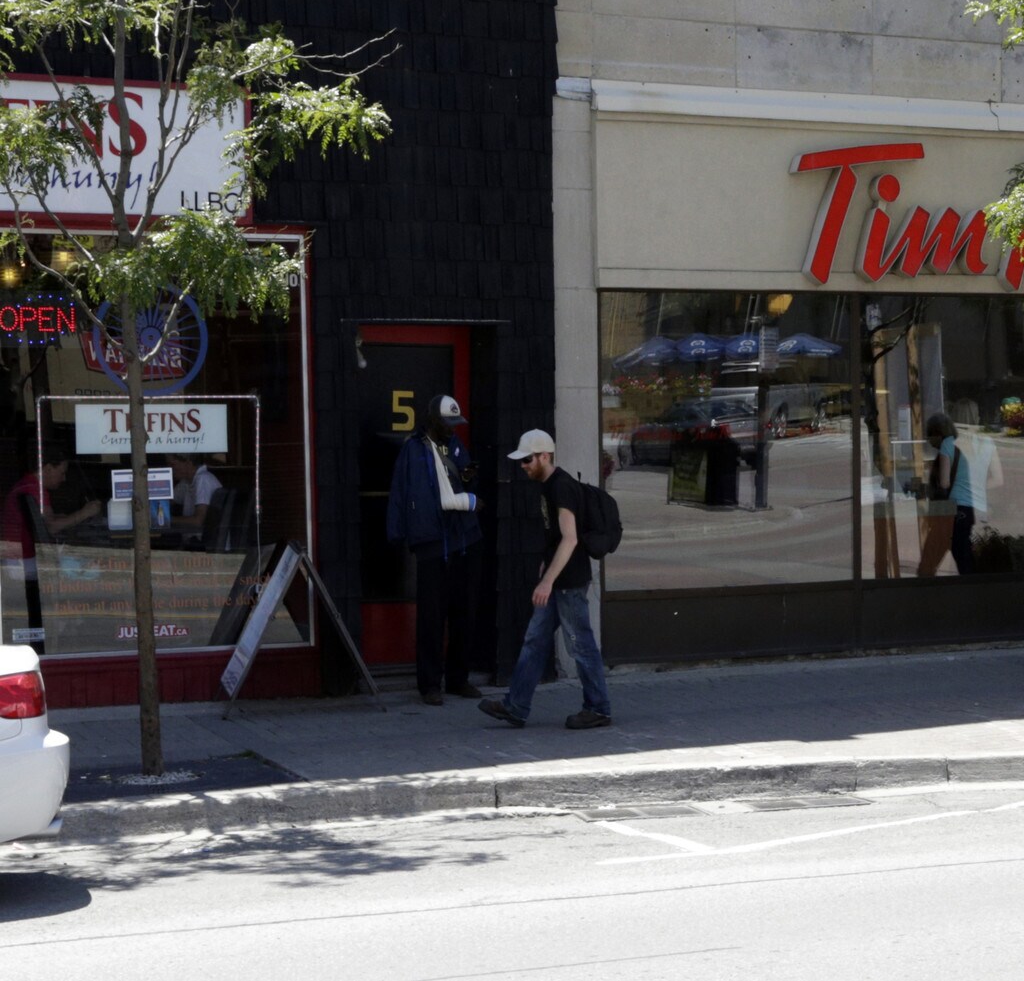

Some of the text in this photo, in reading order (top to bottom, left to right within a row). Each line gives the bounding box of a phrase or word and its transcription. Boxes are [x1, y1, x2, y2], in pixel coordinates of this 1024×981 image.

[790, 141, 990, 286] Tim
[0, 306, 76, 332] OPEN
[103, 408, 202, 434] TIFINS
[392, 390, 415, 431] 5
[101, 434, 132, 445] Curr
[166, 432, 205, 451] hurry!
[169, 593, 208, 611] during
